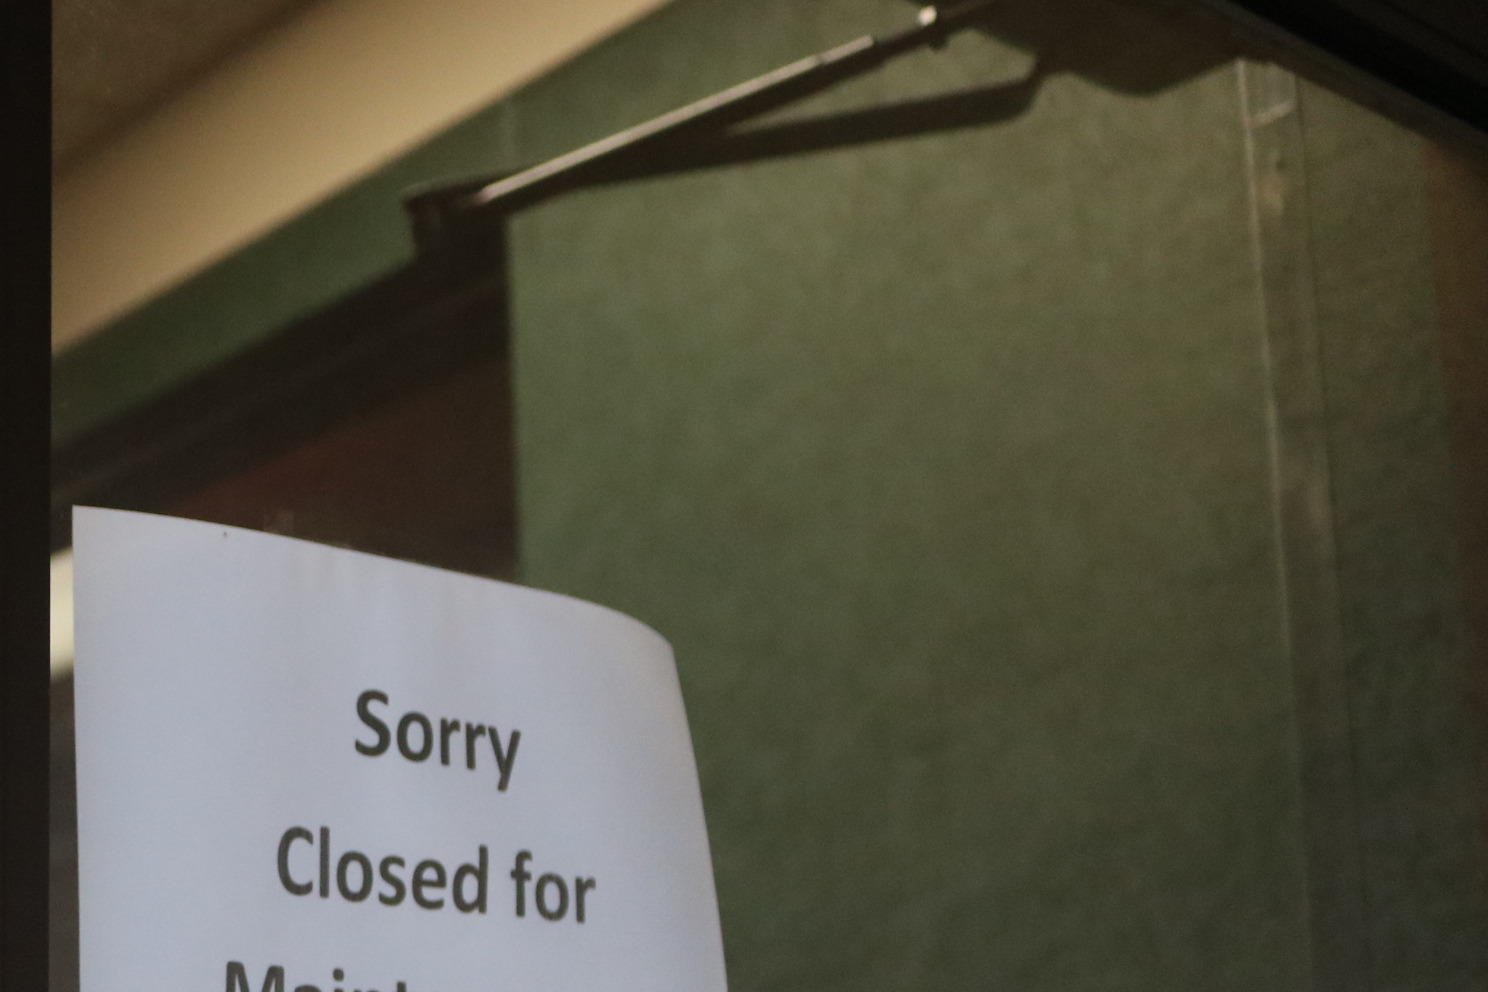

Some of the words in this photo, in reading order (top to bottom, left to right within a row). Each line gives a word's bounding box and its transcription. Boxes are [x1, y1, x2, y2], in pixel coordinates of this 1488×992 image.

[354, 689, 521, 792] Sorry
[277, 826, 489, 914] Closed
[510, 850, 596, 924] for
